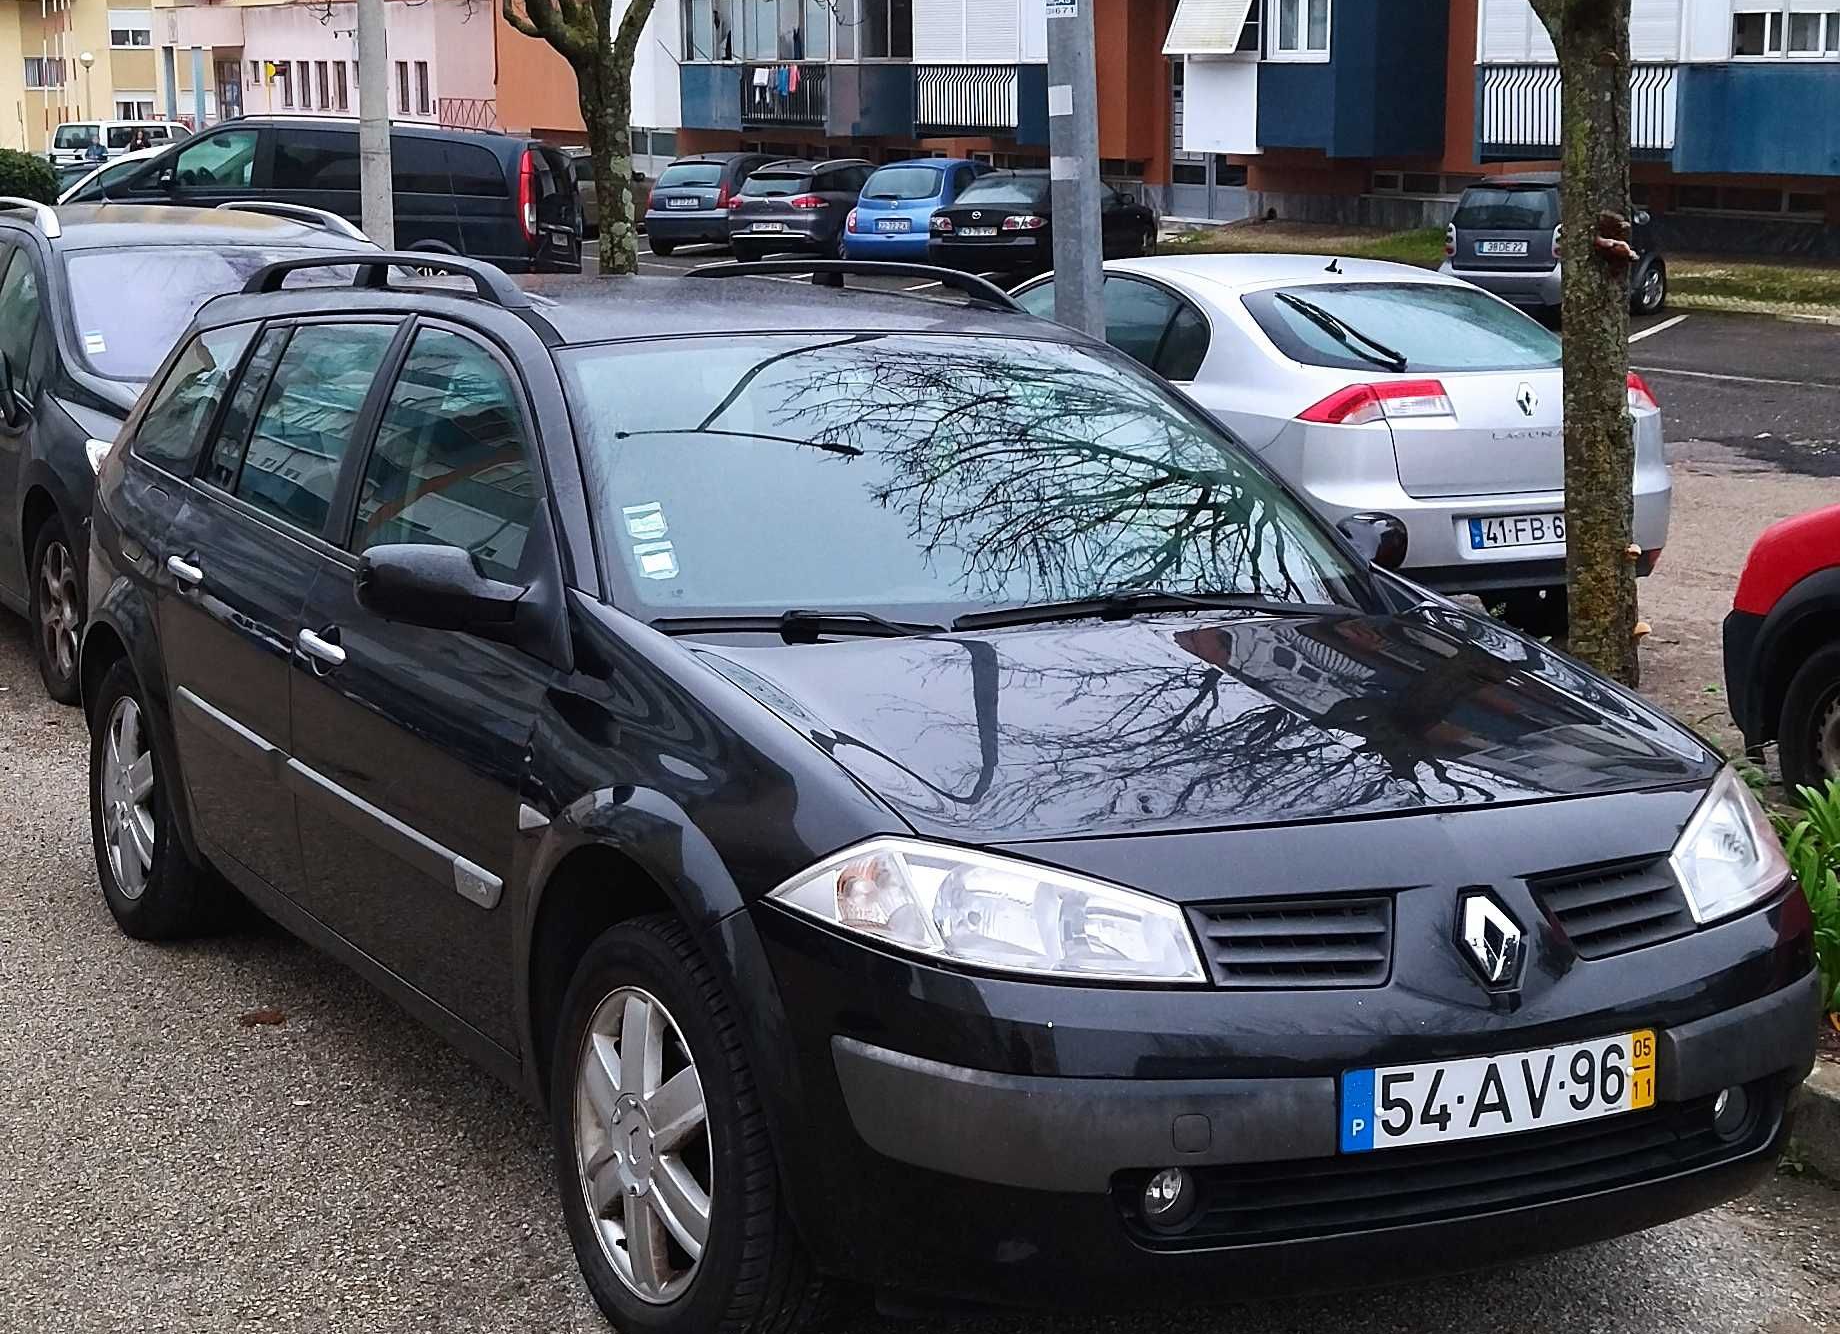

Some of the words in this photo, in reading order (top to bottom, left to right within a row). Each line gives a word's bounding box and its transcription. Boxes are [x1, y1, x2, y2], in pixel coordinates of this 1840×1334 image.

[1633, 1037, 1652, 1059] 05
[1633, 1078, 1651, 1100] 11
[1352, 1118, 1365, 1137] P
